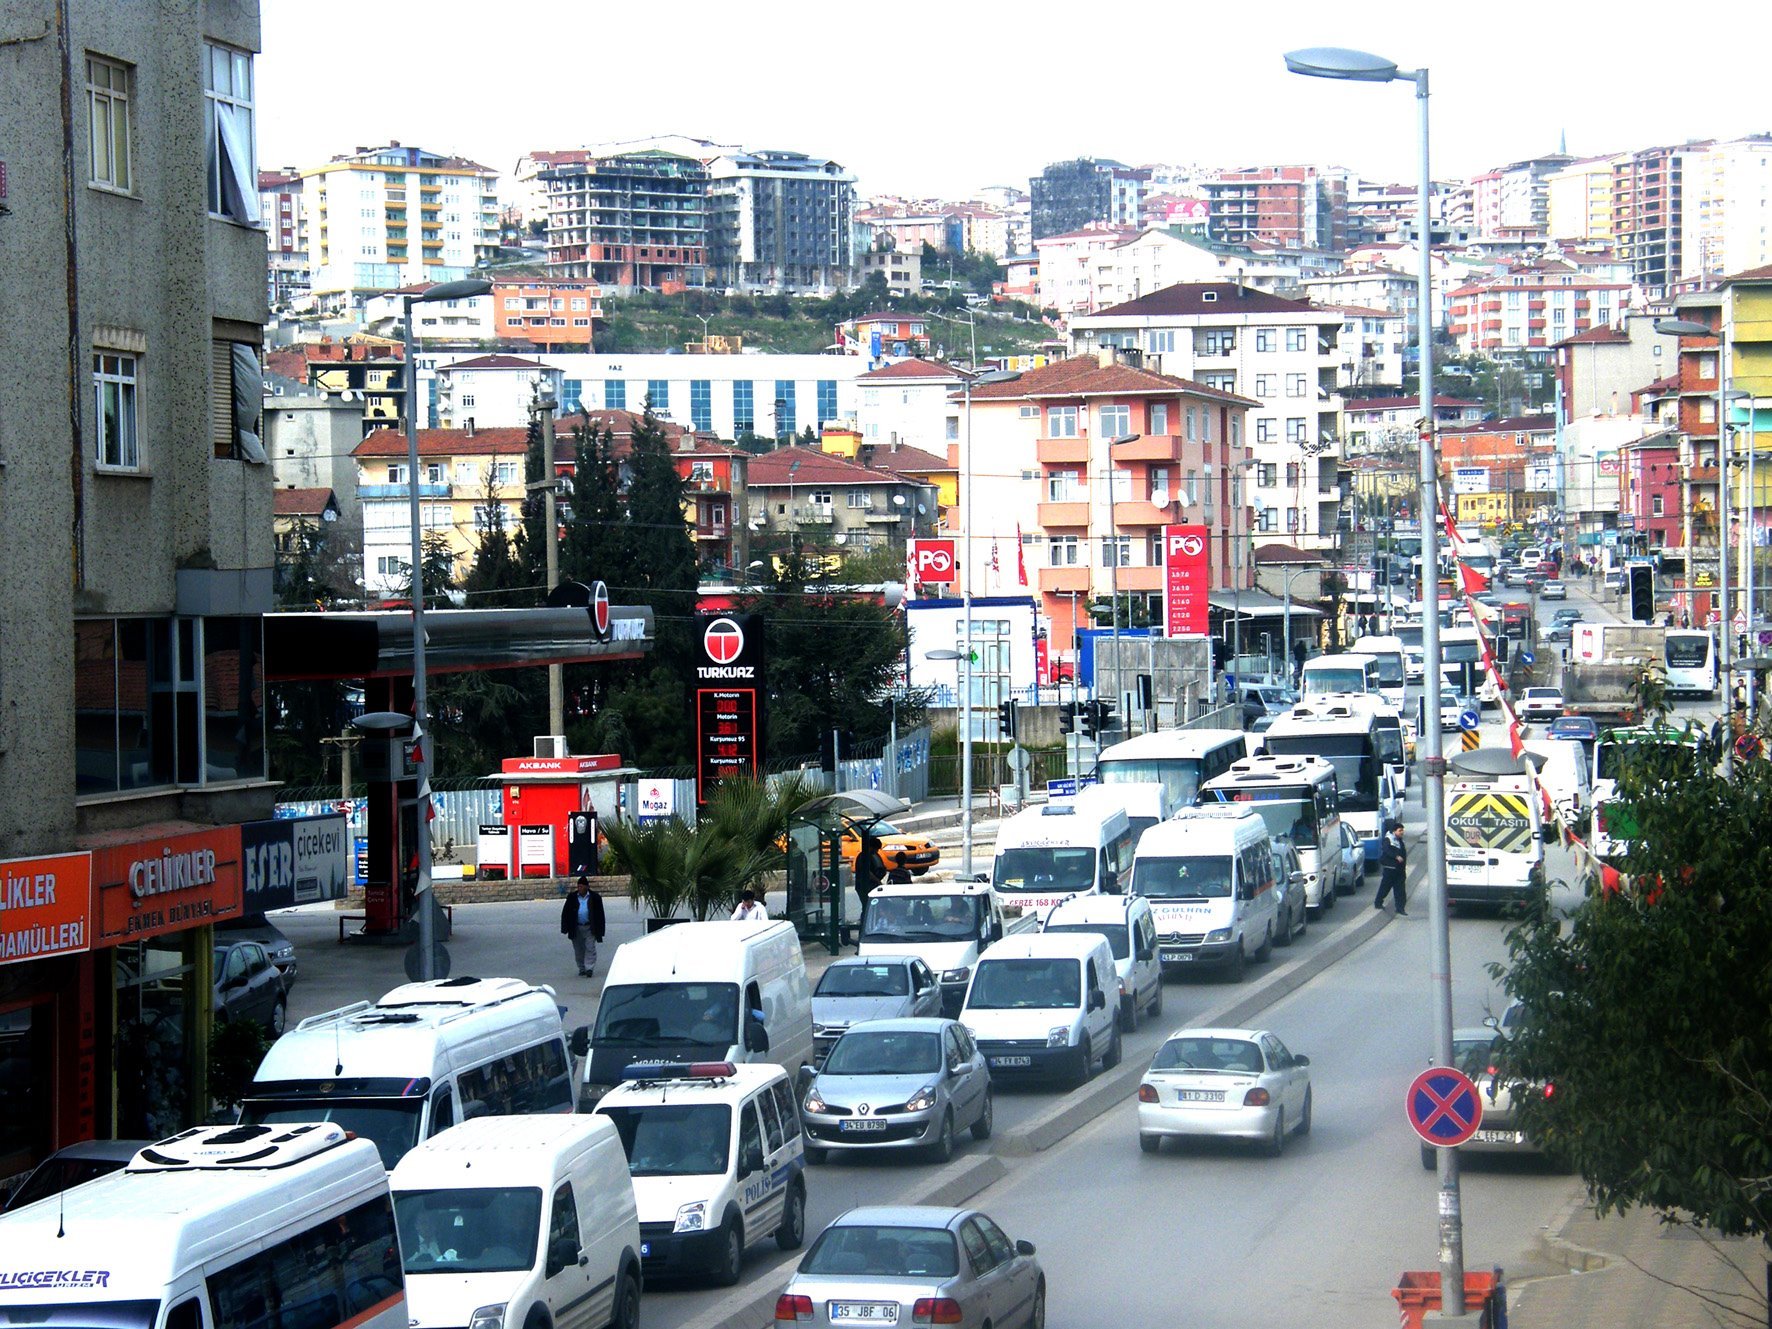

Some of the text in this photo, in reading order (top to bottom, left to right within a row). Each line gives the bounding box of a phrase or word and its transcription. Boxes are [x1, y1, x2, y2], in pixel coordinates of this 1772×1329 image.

[697, 666, 754, 679] TURKUAZ
[579, 761, 598, 769] AKBANK
[642, 800, 667, 811] Mogaz
[1450, 817, 1482, 826] OKUL
[1464, 829, 1481, 840] DUR
[297, 827, 340, 861] çiçekevi
[245, 841, 293, 893] ESER
[128, 847, 216, 908] ÇELİKLER
[1205, 1091, 1224, 1101] 3310
[745, 1175, 771, 1204] POLİS
[838, 1304, 895, 1318] 35 JBF 06
